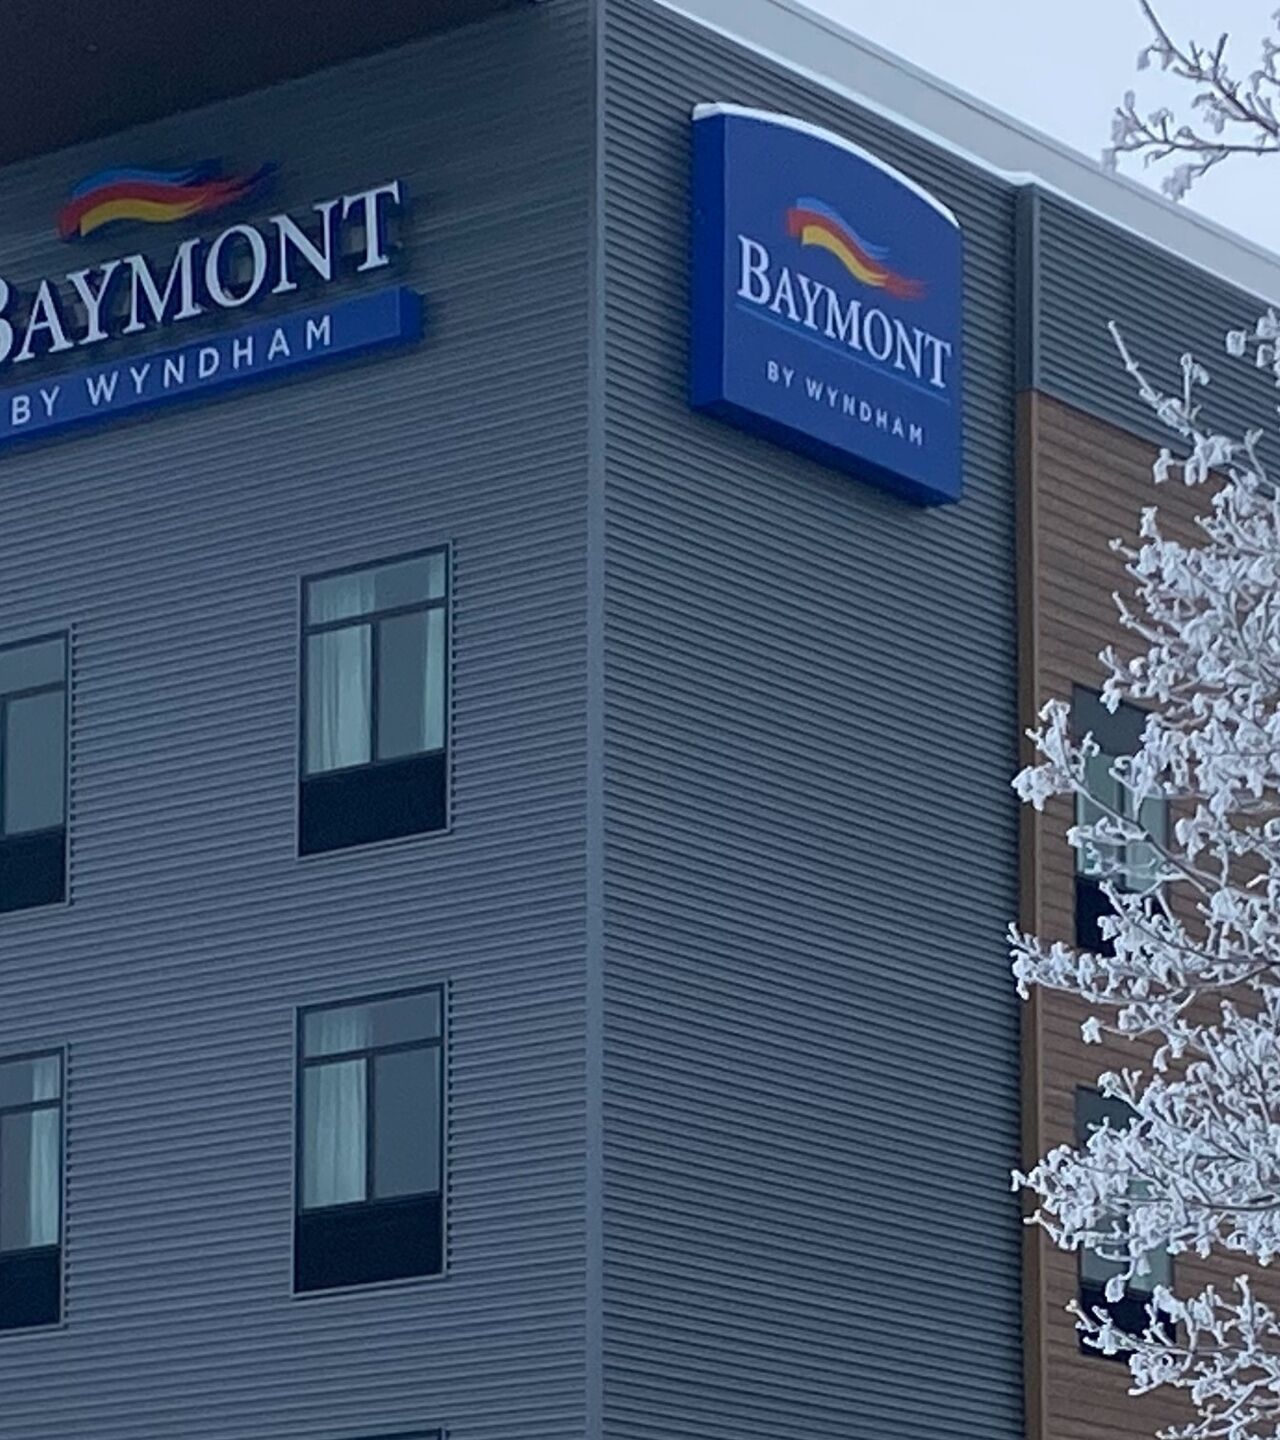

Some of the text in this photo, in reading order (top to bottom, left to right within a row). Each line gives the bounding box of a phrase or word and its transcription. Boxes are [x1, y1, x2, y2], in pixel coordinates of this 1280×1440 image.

[736, 234, 953, 390] BAYMONT
[10, 315, 332, 425] BY WYNDHAM
[766, 360, 924, 447] BY WYNDHAM
